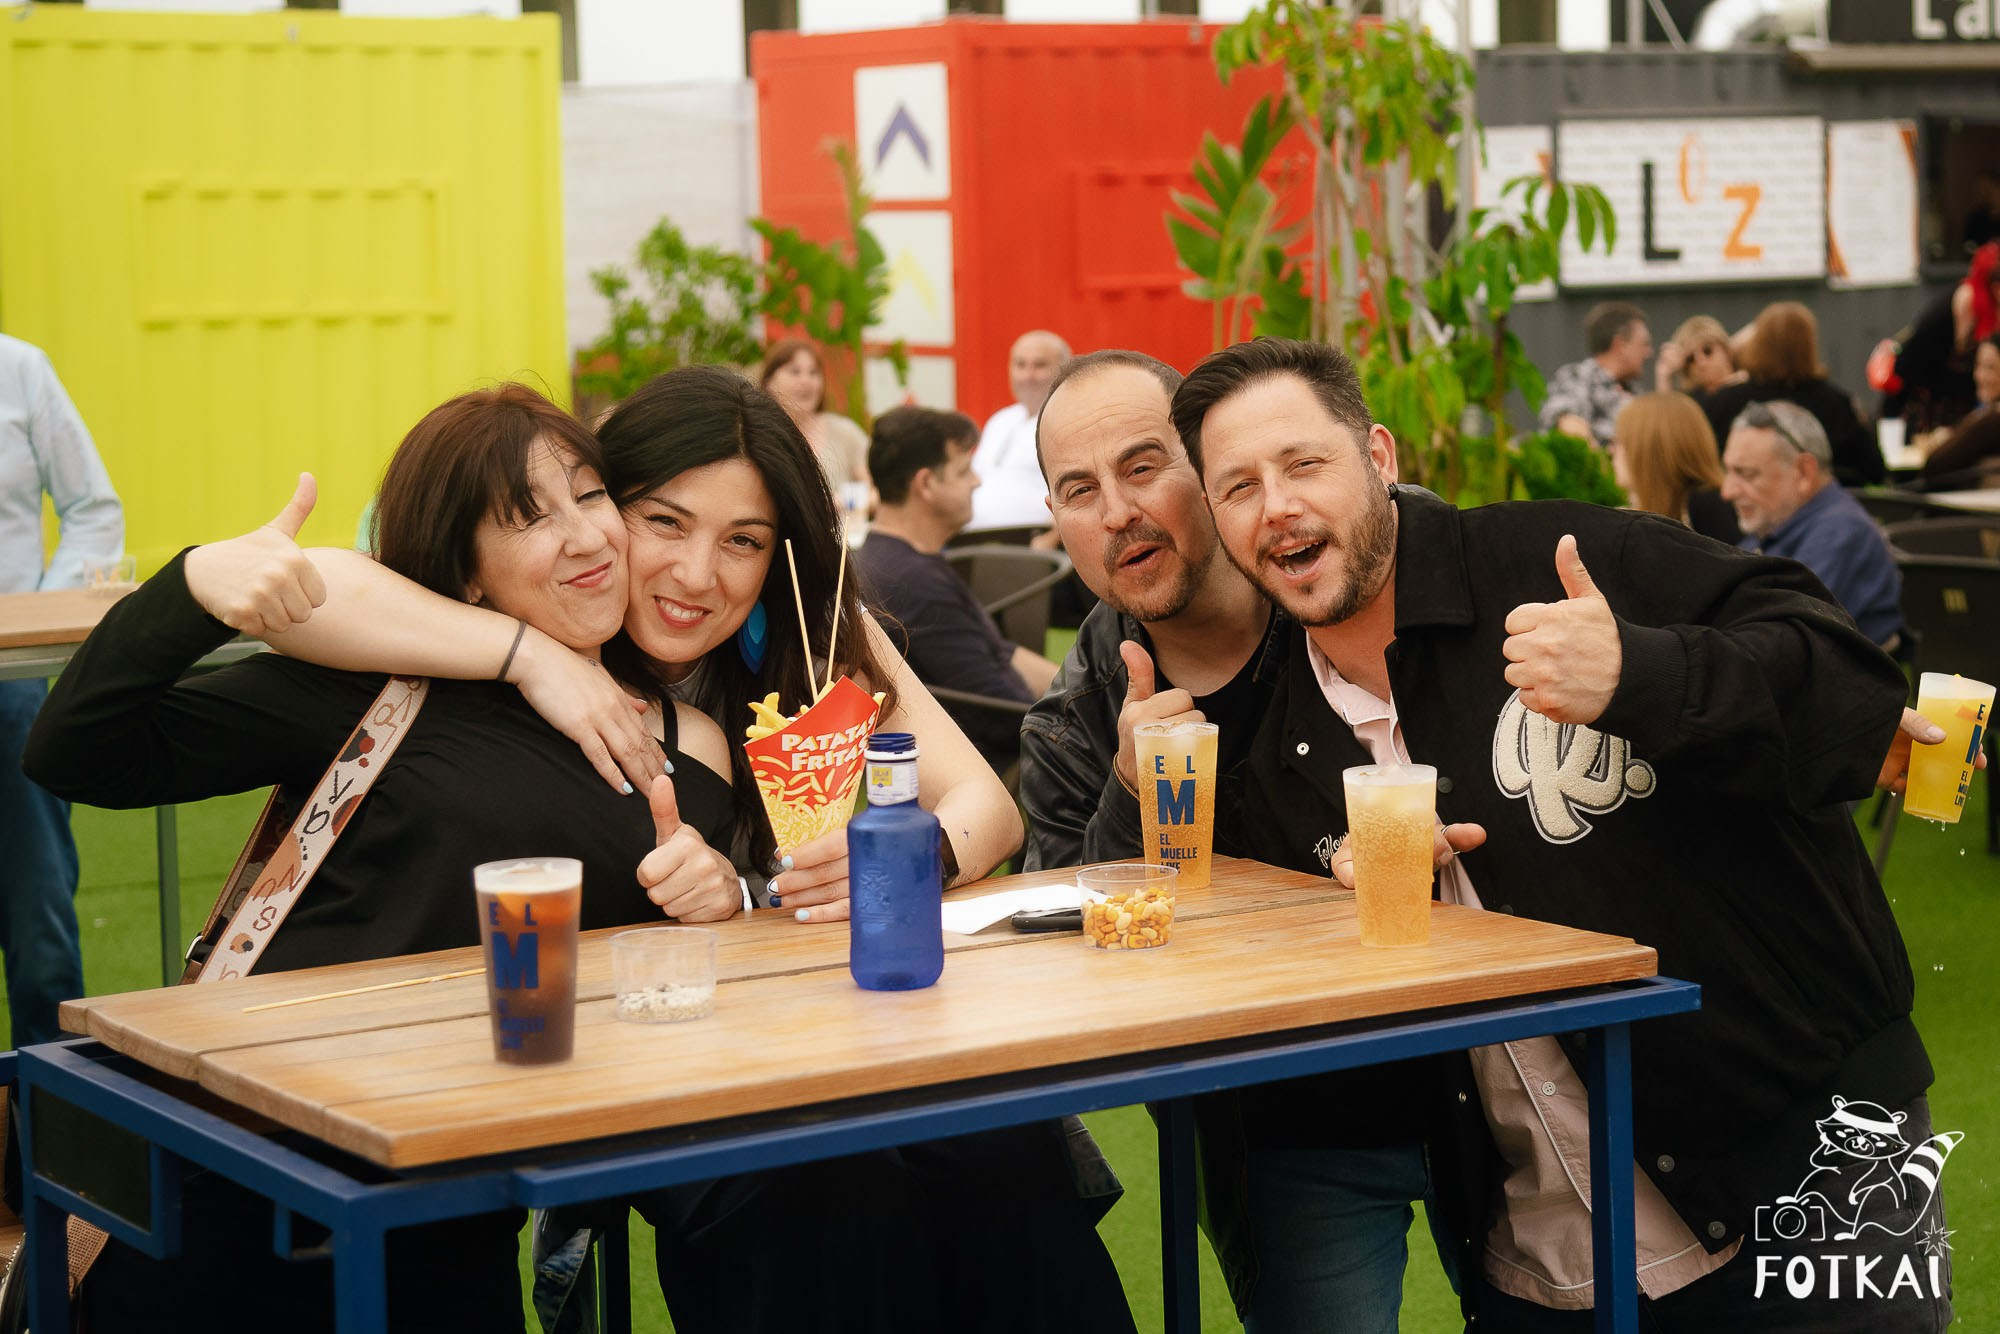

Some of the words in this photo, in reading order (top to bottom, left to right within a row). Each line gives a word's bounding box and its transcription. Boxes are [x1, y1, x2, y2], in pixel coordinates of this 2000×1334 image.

[1912, 0, 2000, 40] La
[781, 709, 877, 752] PATATAS
[791, 732, 869, 772] FRITAS
[1156, 779, 1196, 825] M
[1159, 833, 1171, 845] EL
[1159, 847, 1198, 859] MUELLE
[491, 932, 540, 989] M
